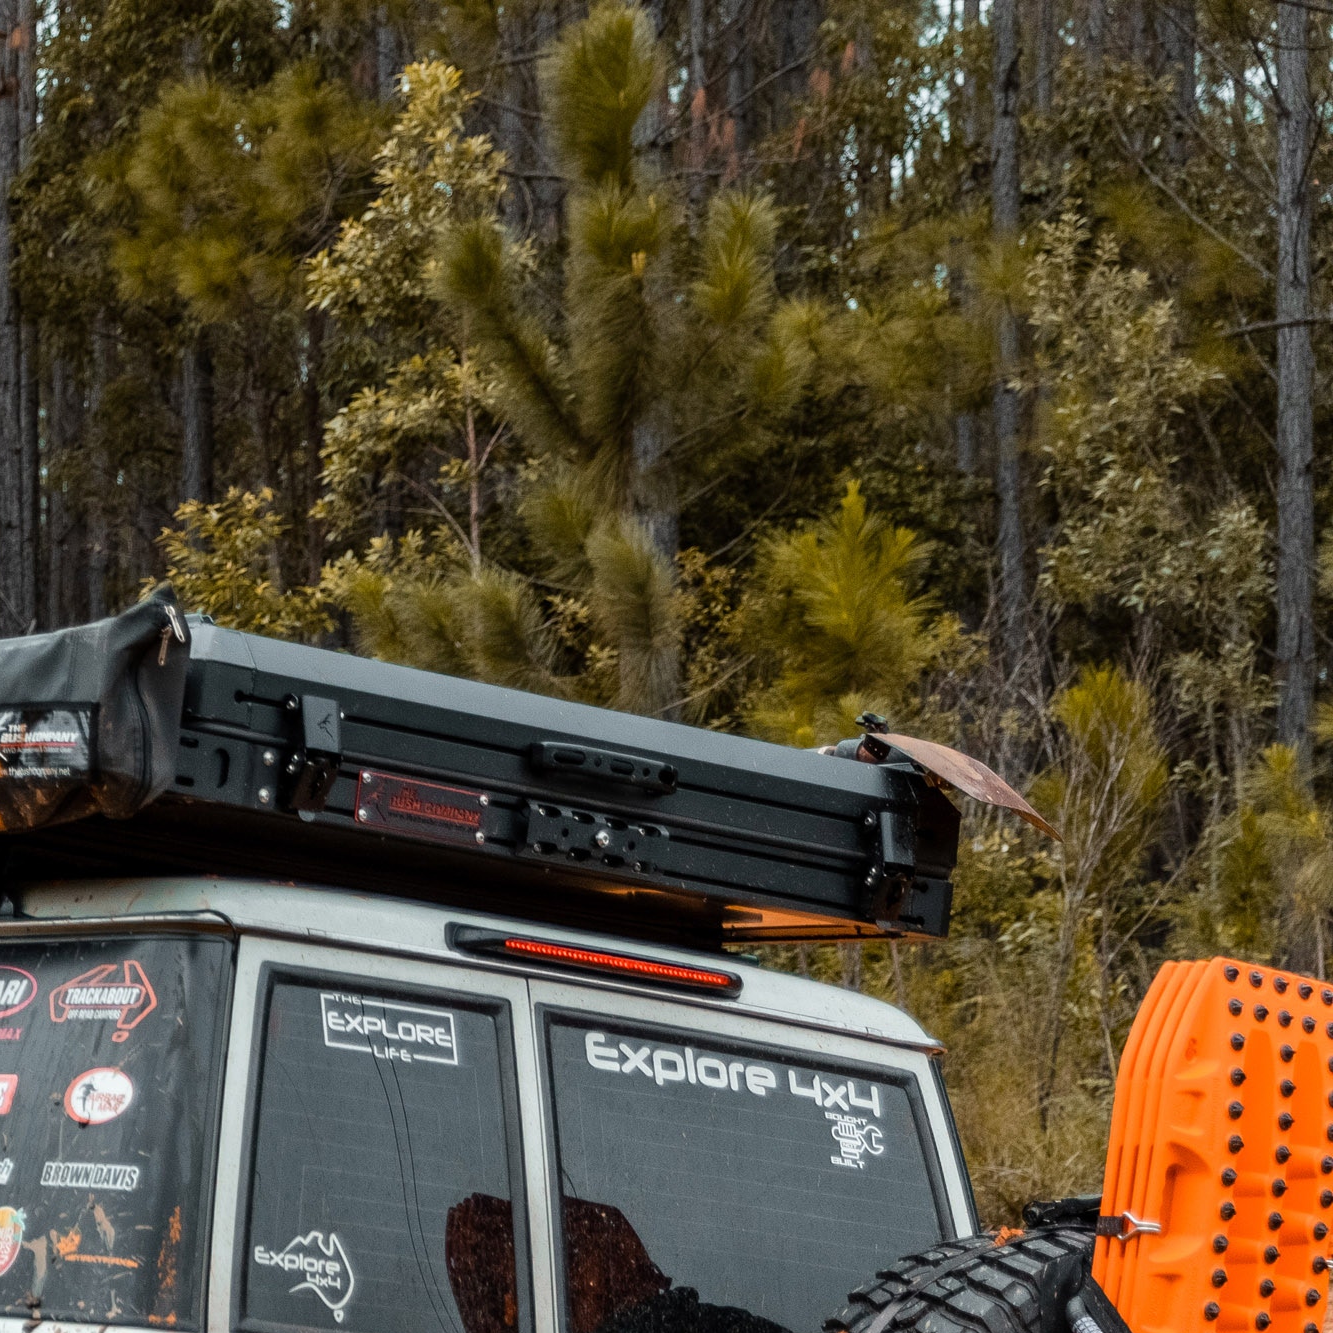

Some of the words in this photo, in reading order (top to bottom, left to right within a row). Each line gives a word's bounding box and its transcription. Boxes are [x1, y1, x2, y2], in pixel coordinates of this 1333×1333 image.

[65, 986, 140, 1005] TRACKABOUT
[333, 993, 362, 1005] THE
[327, 1010, 453, 1047] EXPLORE
[373, 1045, 412, 1062] LIFE
[585, 1032, 776, 1096] Explore
[788, 1069, 881, 1118] 4x4
[824, 1111, 868, 1126] BOUGHT
[830, 1156, 865, 1169] BUILT
[42, 1164, 93, 1186] BROWN
[93, 1165, 137, 1188] DAVIS
[254, 1245, 341, 1275] Explore
[306, 1272, 341, 1290] 4x4
